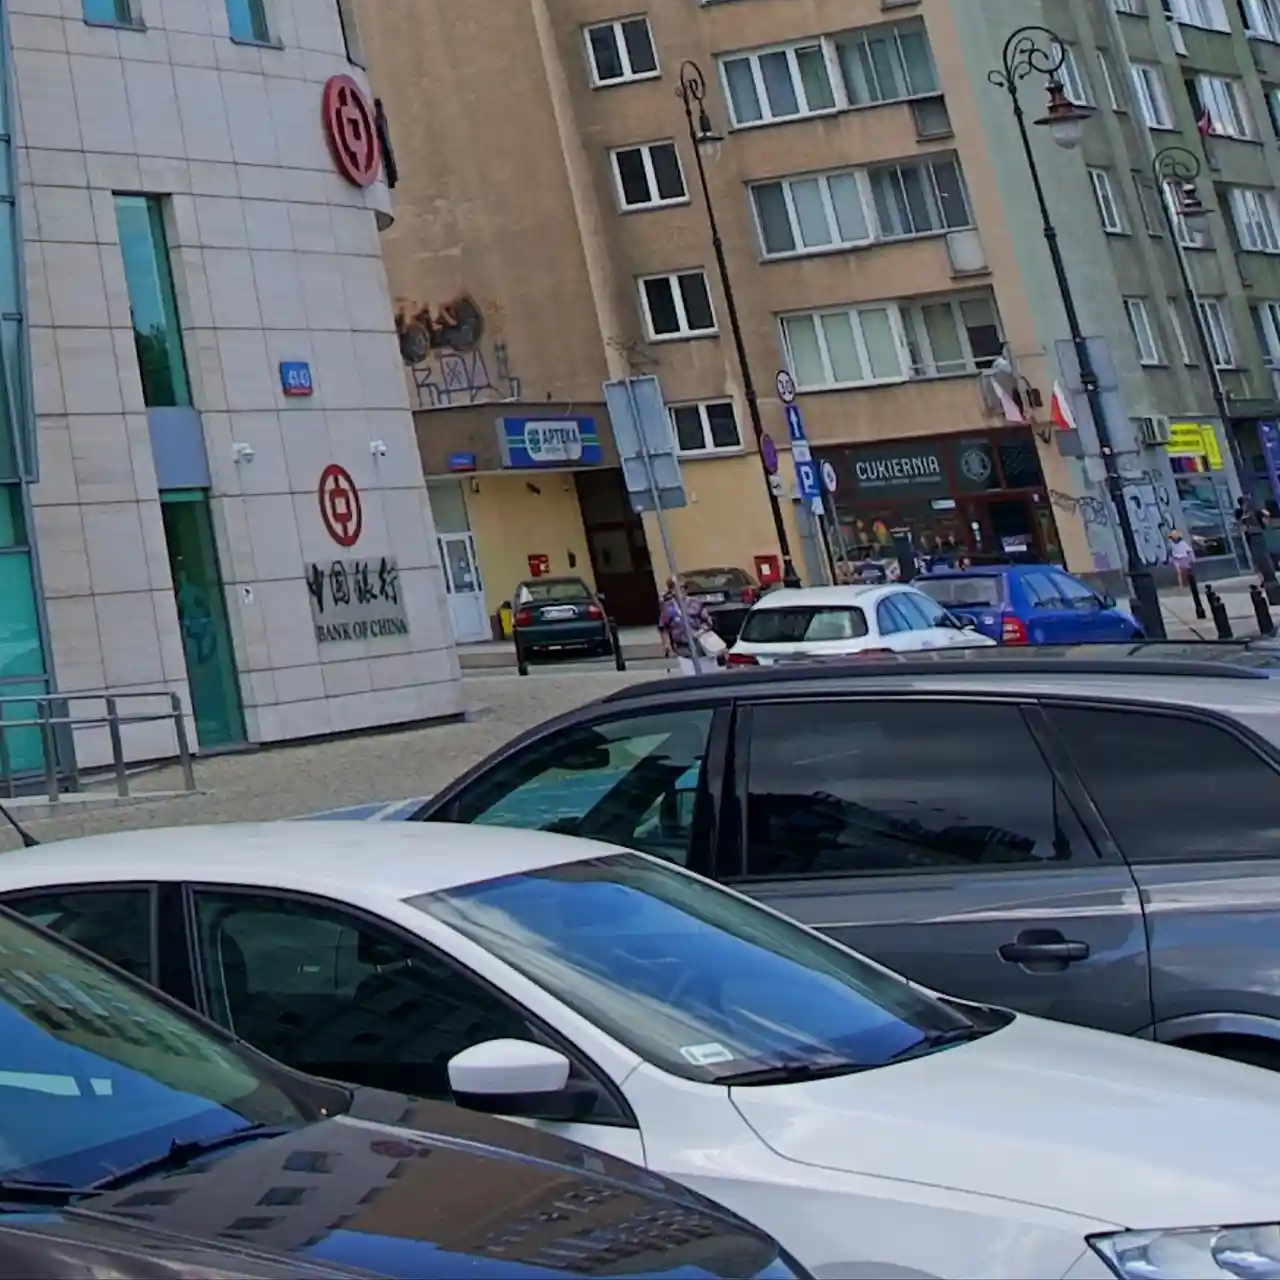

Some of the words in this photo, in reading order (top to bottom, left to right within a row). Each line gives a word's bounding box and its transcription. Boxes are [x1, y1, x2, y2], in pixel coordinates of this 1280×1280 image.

[541, 427, 580, 445] APTEKA
[856, 455, 940, 480] CUKIERNIA
[317, 623, 352, 643] BANK
[353, 620, 368, 639] OF
[370, 618, 409, 637] CHINA
